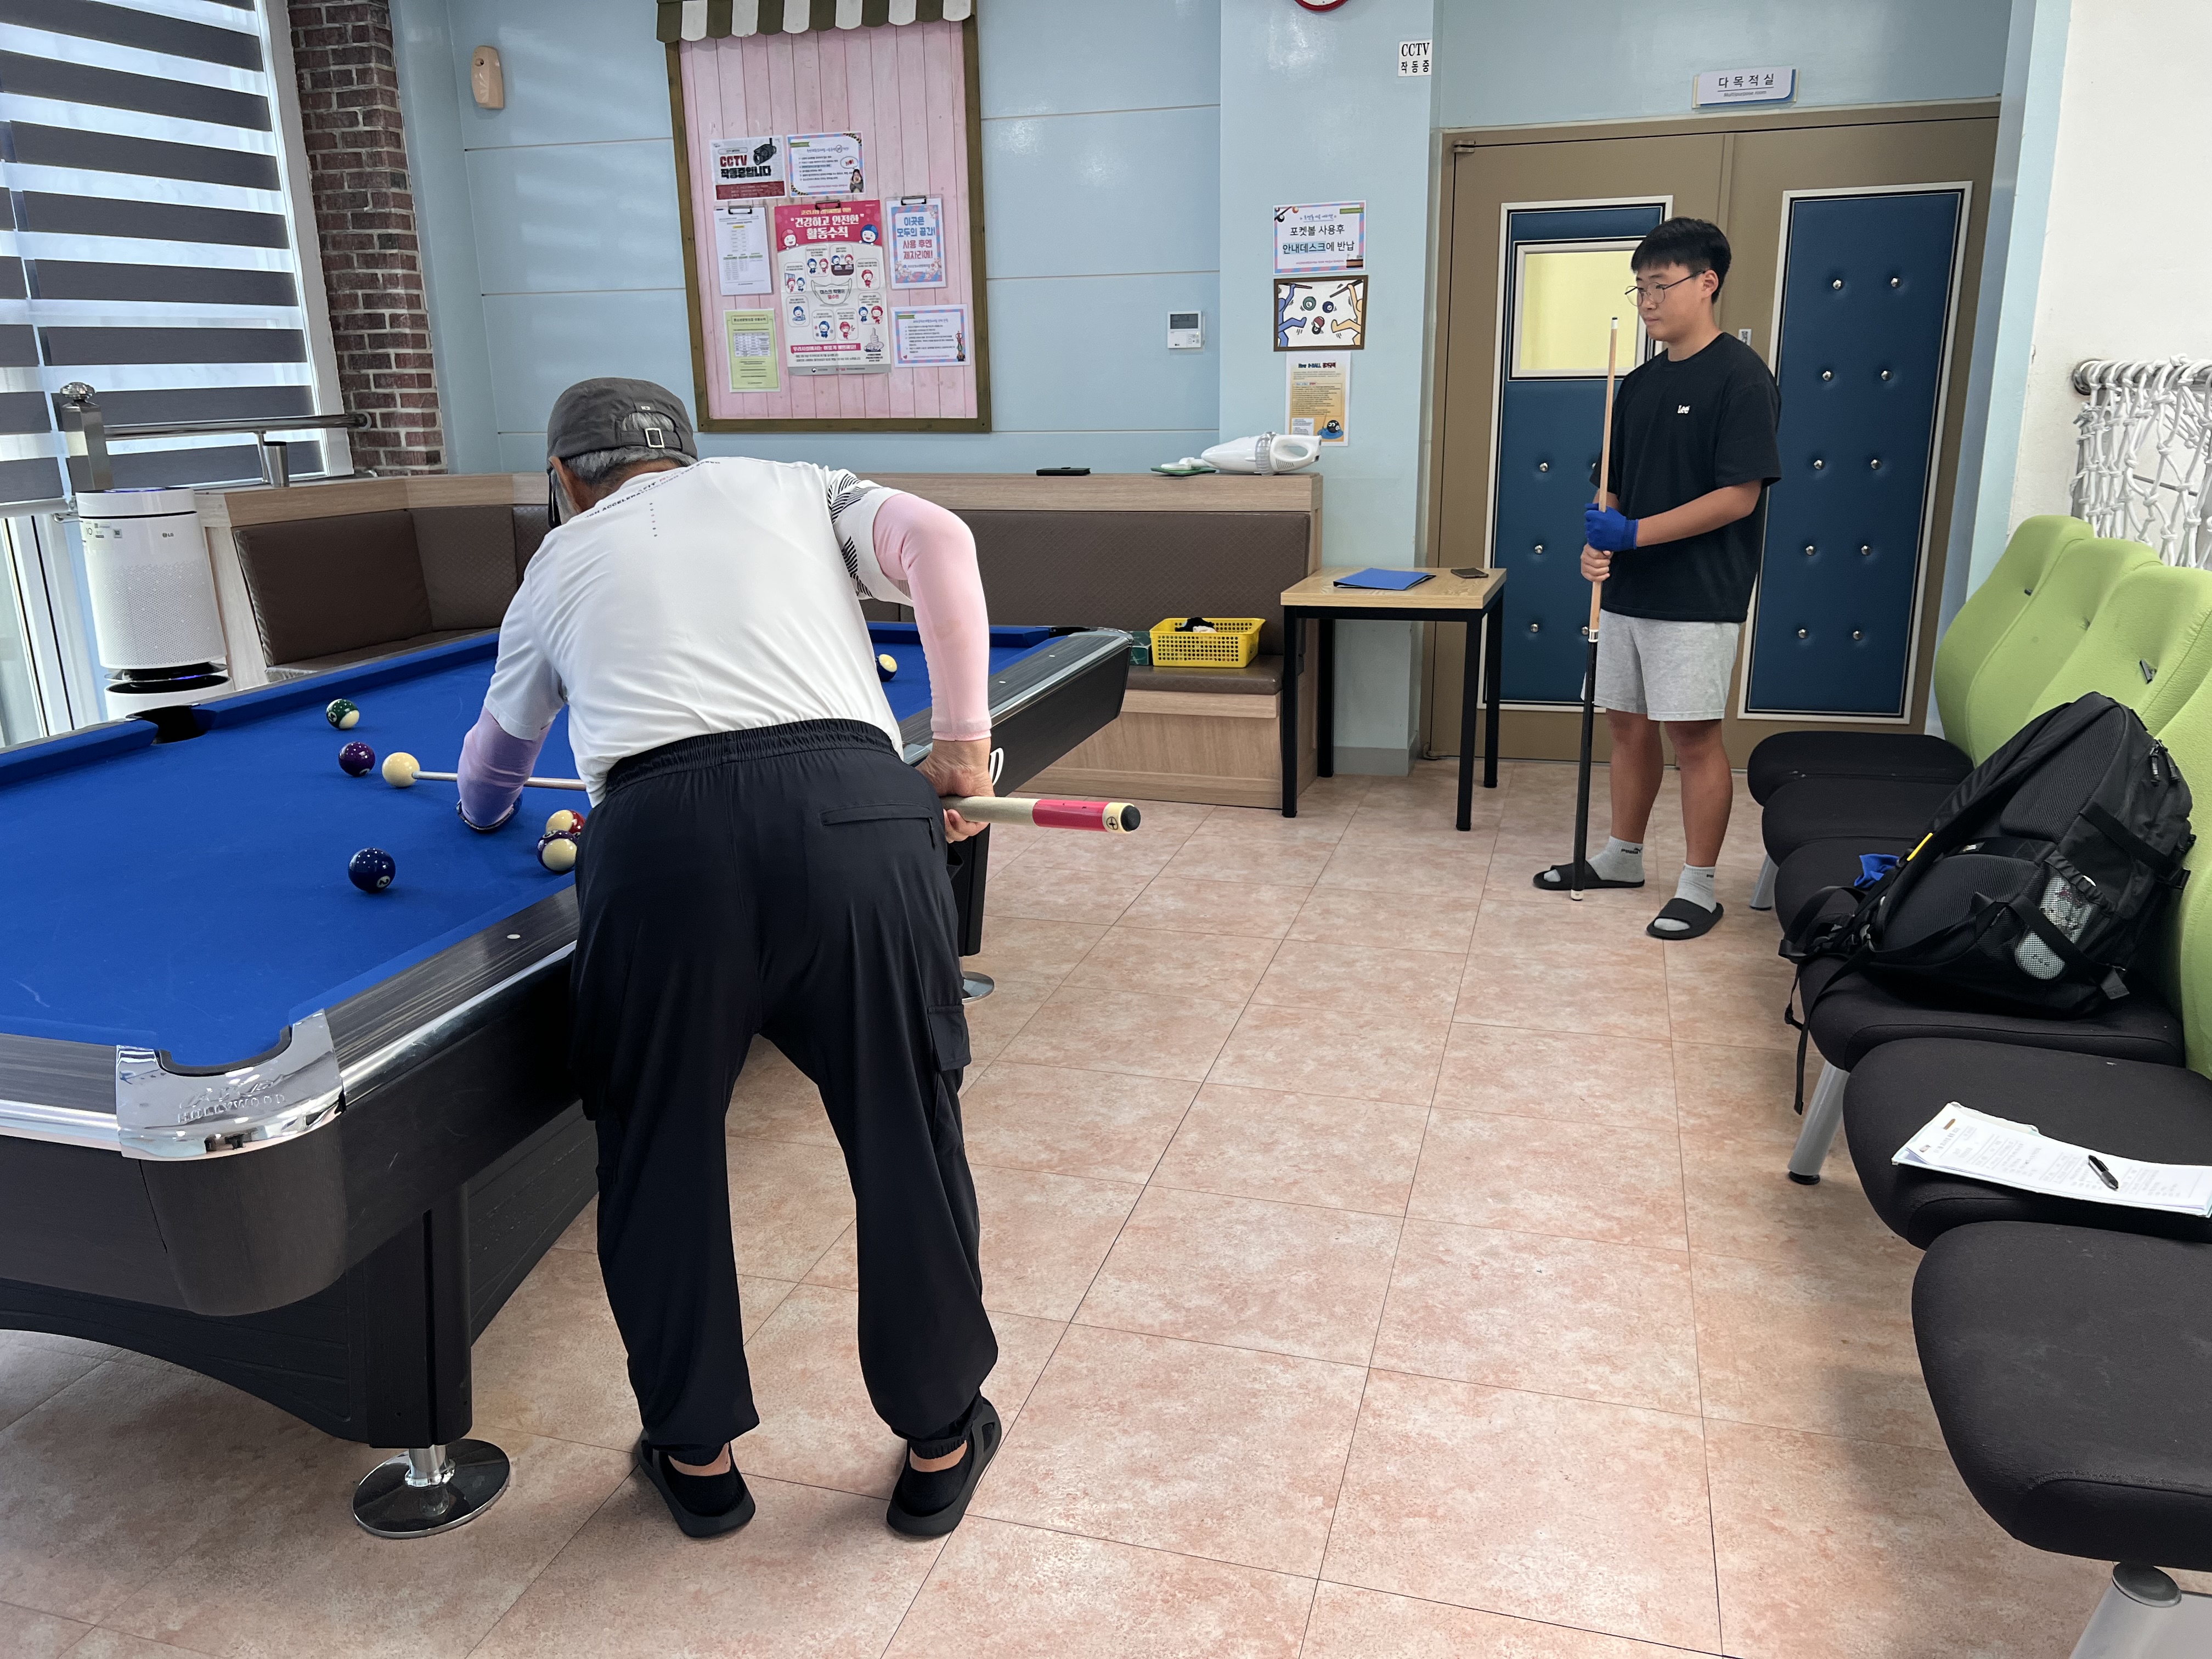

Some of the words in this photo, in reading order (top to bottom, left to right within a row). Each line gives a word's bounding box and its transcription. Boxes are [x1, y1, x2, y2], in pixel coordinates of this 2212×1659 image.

[1401, 42, 1430, 57] CCTV
[1718, 73, 1774, 88] 다목적실
[720, 155, 747, 167] CCTV
[720, 165, 771, 179] 작동중입니다
[904, 216, 924, 226] 이곳은
[806, 226, 848, 240] 활동수칙
[897, 228, 917, 238] 모두의
[1290, 225, 1316, 236] 포켓볼
[1318, 224, 1345, 235] 사용후
[902, 240, 916, 249] 사용
[1283, 242, 1335, 254] 안내데스크에
[1338, 240, 1355, 251] 반납
[903, 251, 933, 260] 제자리에!
[1677, 404, 1690, 414] Lee
[178, 1094, 285, 1123] HOLLYWOOD
